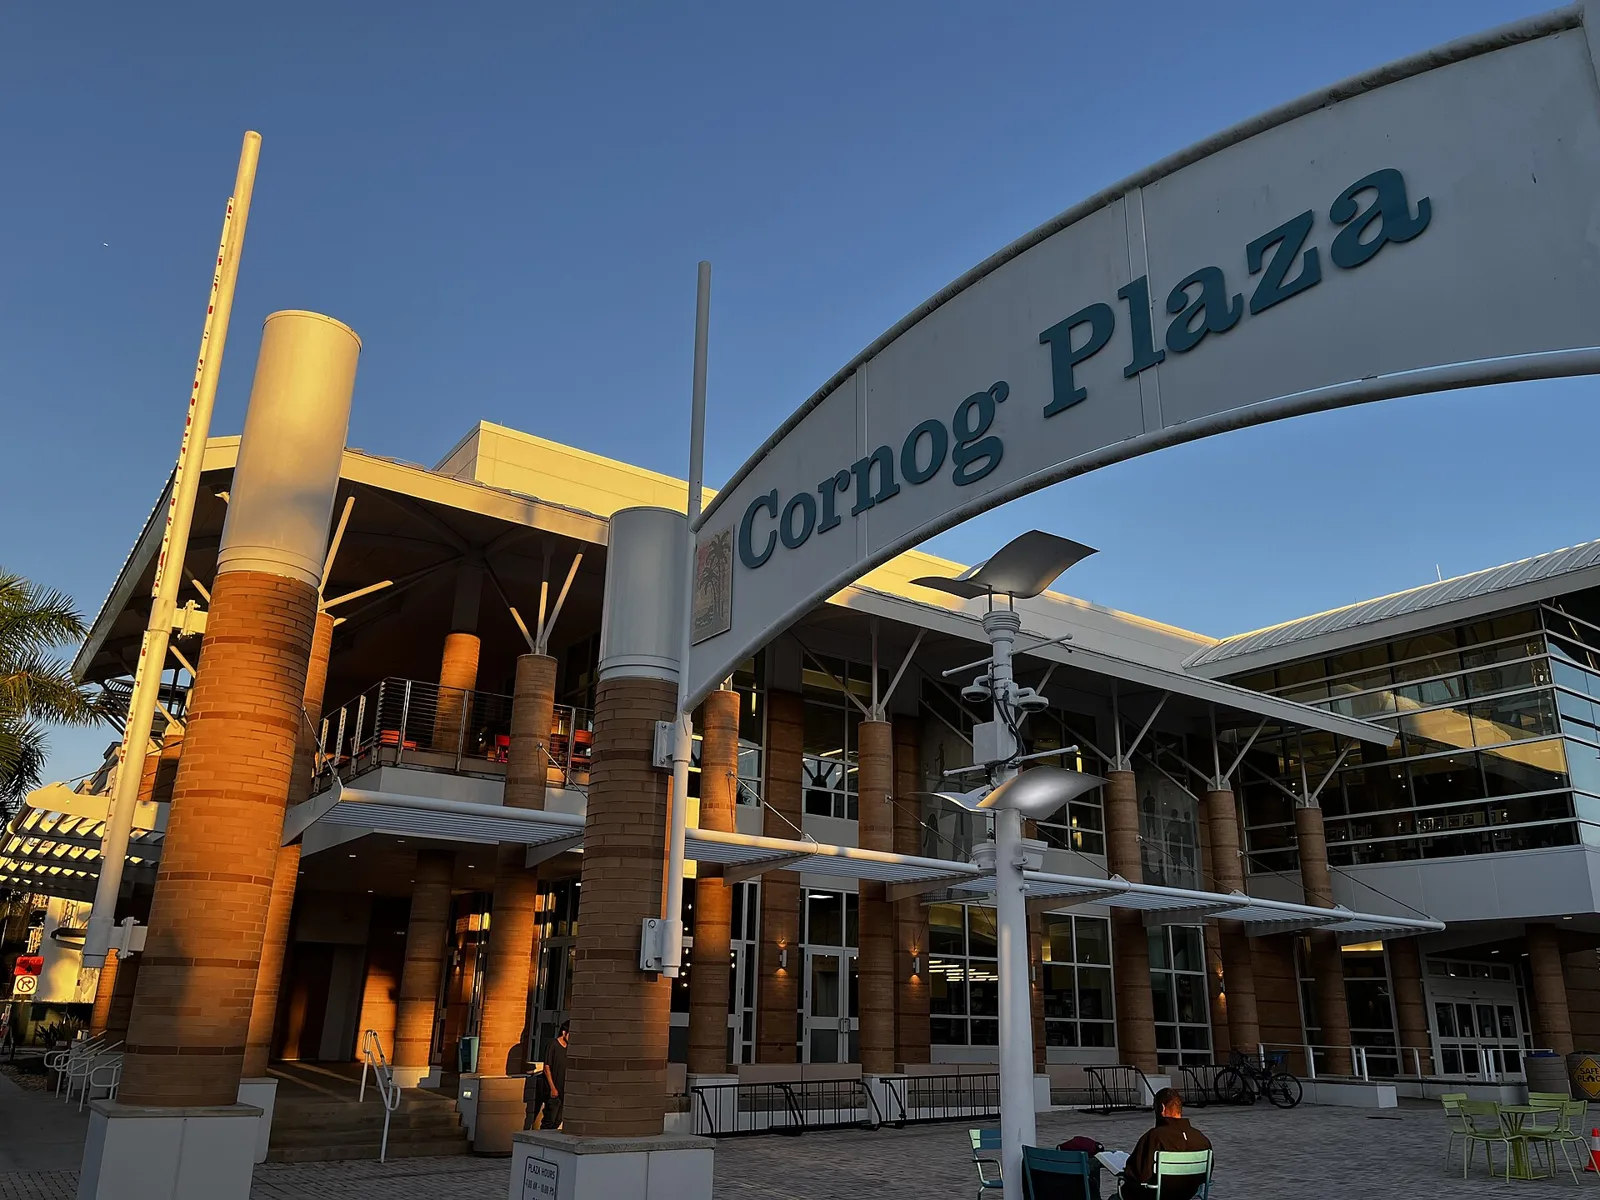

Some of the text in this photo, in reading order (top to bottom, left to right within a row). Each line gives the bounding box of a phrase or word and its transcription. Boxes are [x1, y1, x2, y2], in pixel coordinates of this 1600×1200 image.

[737, 168, 1432, 570] Cornog Plaza
[528, 1163, 556, 1180] PLAZA HOURS
